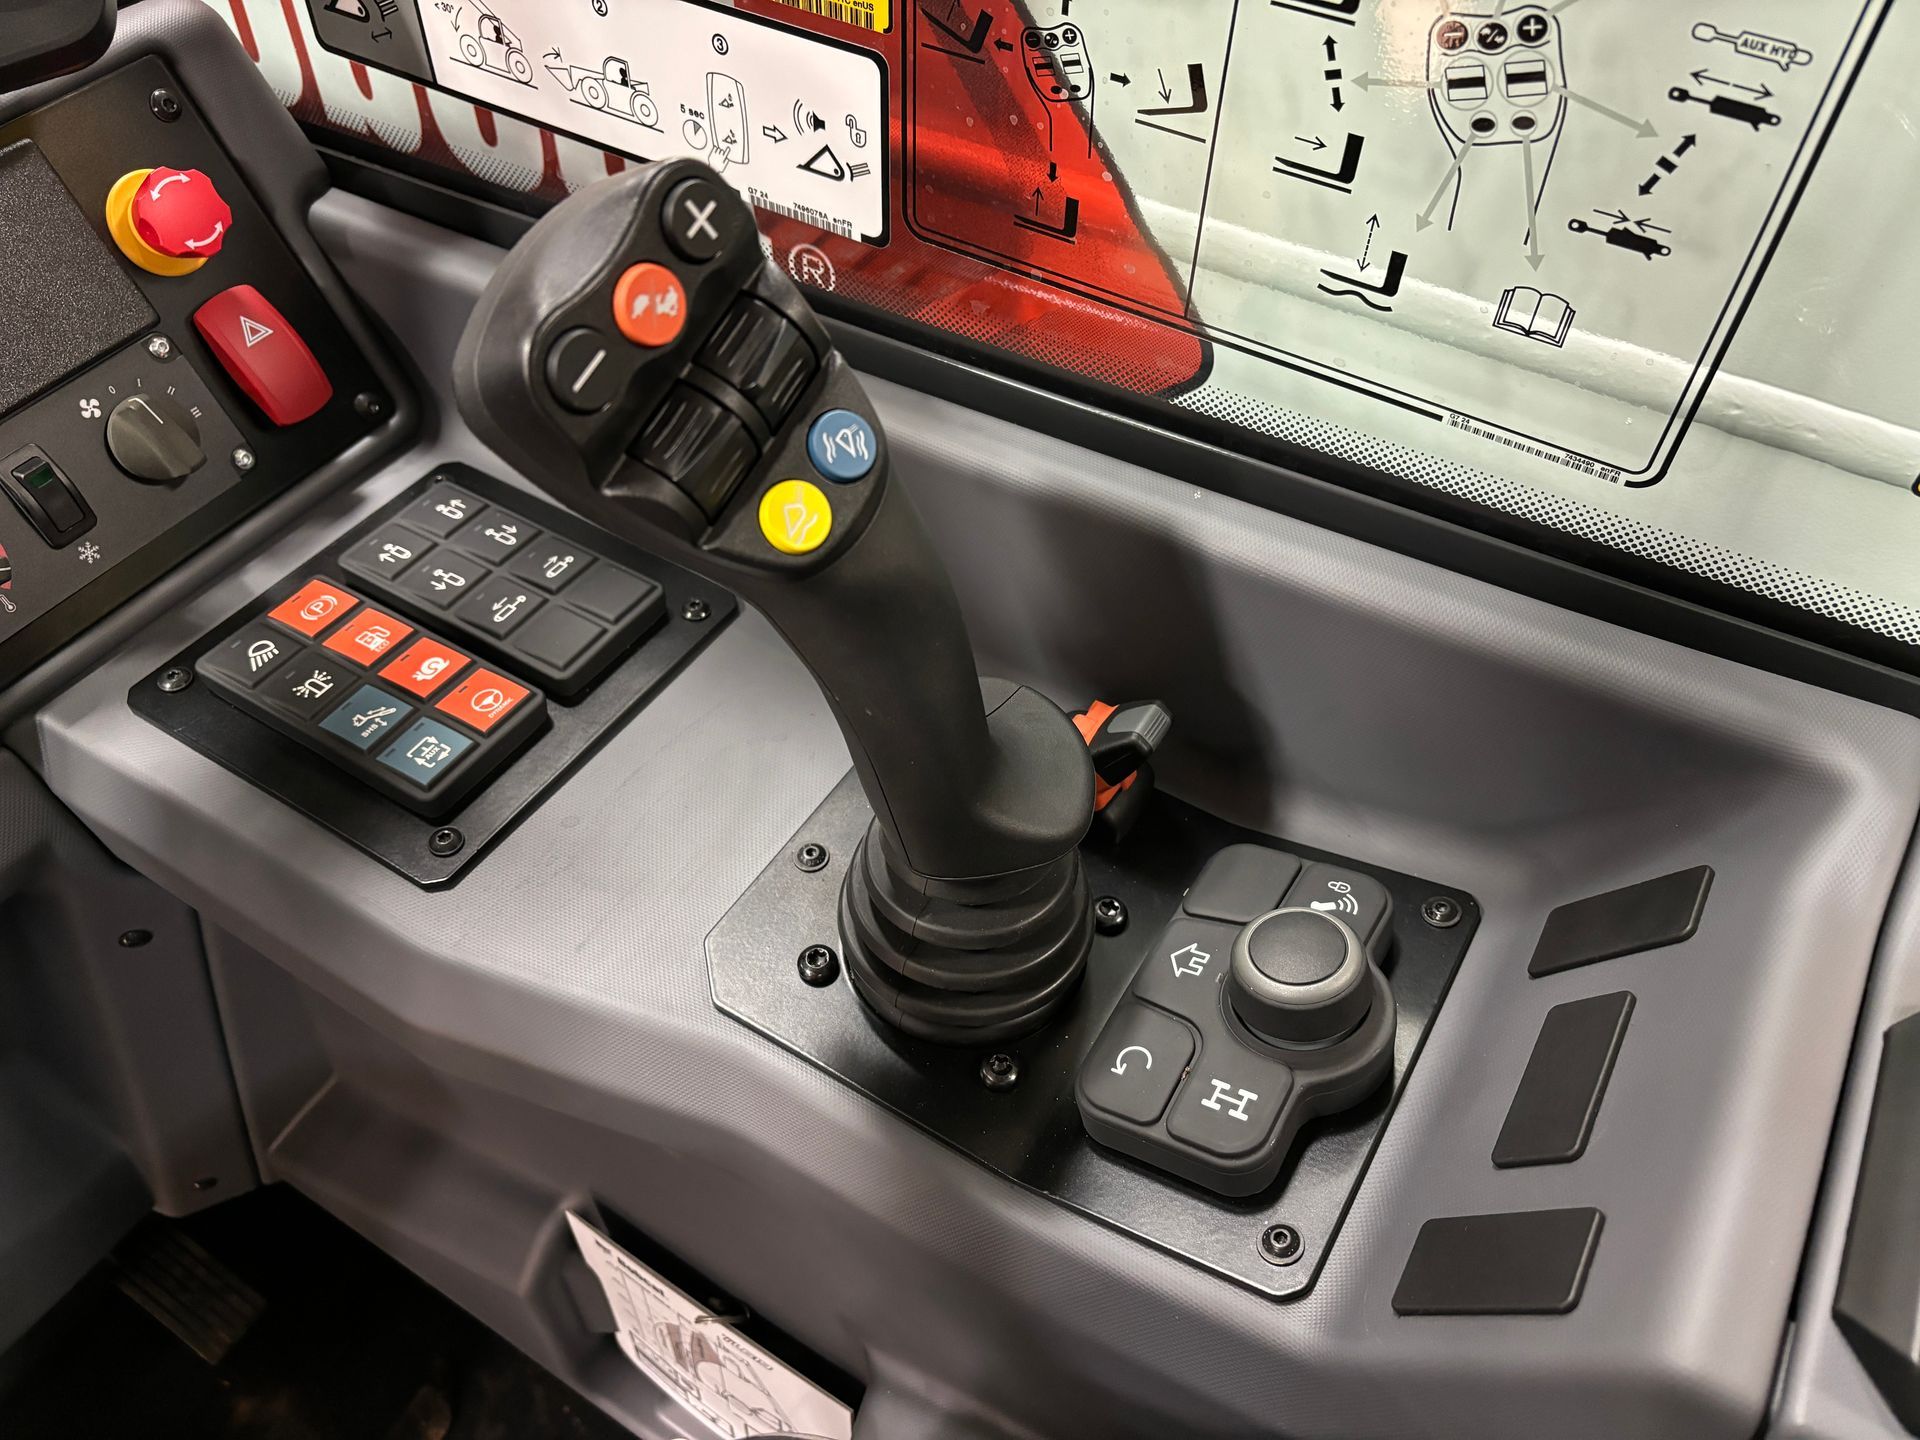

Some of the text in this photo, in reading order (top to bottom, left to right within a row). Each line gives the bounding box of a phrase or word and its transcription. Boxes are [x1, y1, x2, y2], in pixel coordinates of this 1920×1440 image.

[853, 0, 874, 12] enUS
[1741, 37, 1766, 54] AUX
[680, 103, 705, 120] 5 sec
[1449, 413, 1622, 477] G7 24 7434490 enFR
[425, 745, 440, 760] AUX
